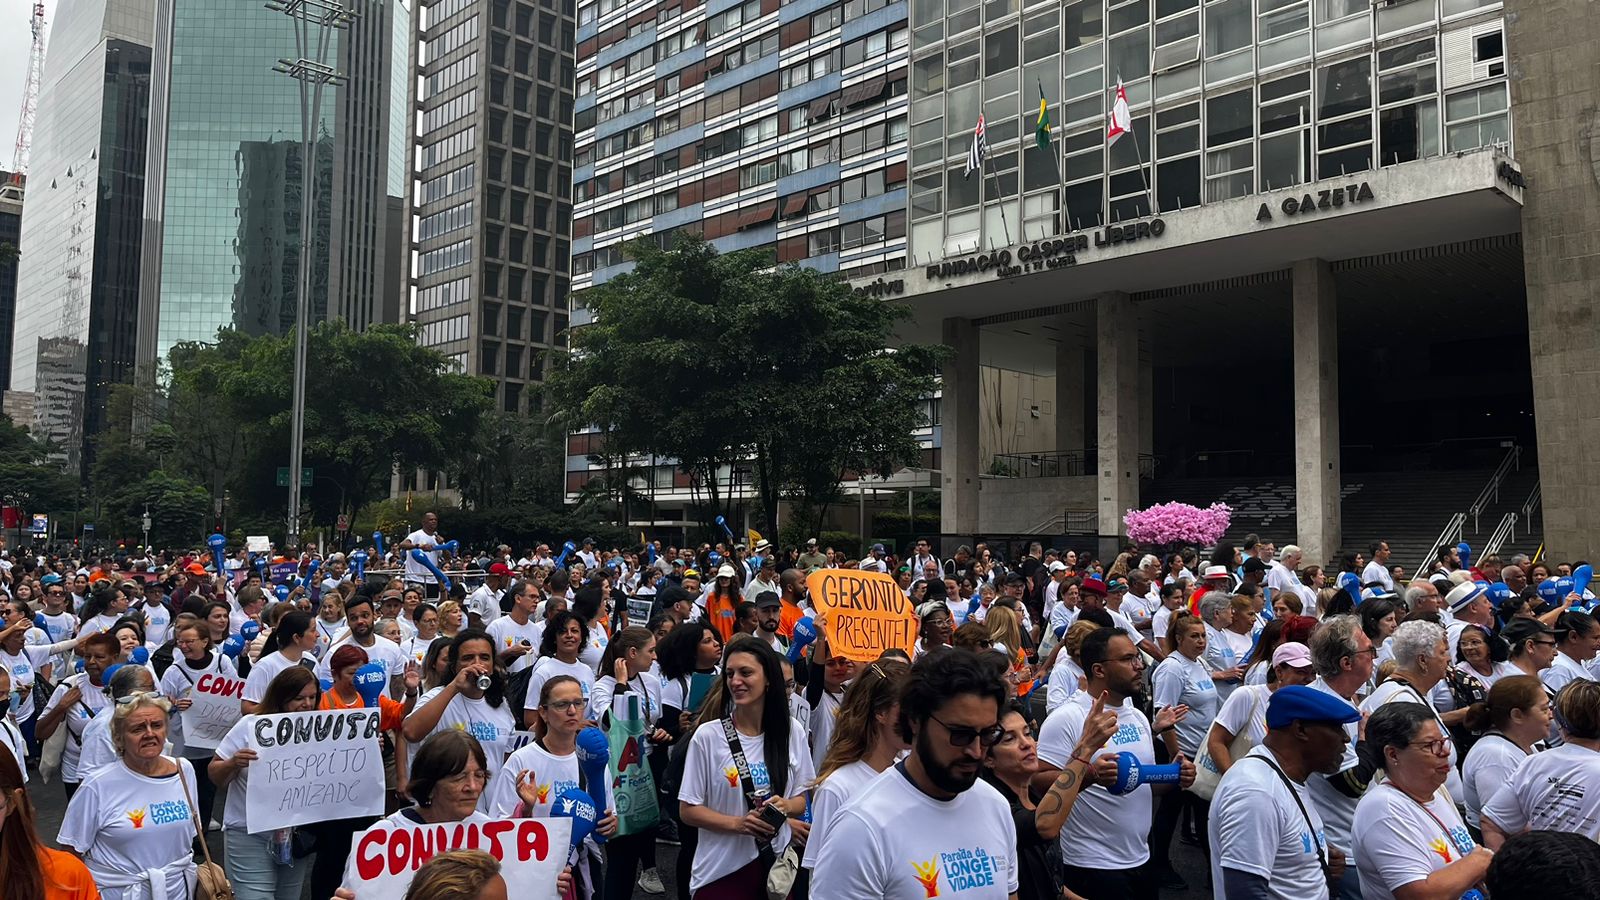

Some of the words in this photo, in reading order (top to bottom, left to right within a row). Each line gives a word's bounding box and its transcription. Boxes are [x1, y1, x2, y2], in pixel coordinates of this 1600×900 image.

[1256, 202, 1272, 220] A
[1281, 182, 1374, 215] GAZETA
[926, 248, 1012, 280] FUNDAÇÃO
[1018, 235, 1089, 262] CÁSPER
[1095, 218, 1165, 247] LÍBERO
[1024, 263, 1030, 273] E
[852, 277, 904, 297] ortiva
[821, 574, 905, 615] GERONTO
[836, 614, 909, 651] PRESENTE!
[254, 711, 381, 748] CONVITA
[1112, 735, 1140, 746] VIDADE
[150, 804, 187, 818] LONGE
[152, 811, 189, 825] VIDADE
[940, 848, 973, 863] Parada
[975, 847, 987, 857] da
[944, 856, 991, 878] LONGE
[948, 872, 994, 892] VIDADE
